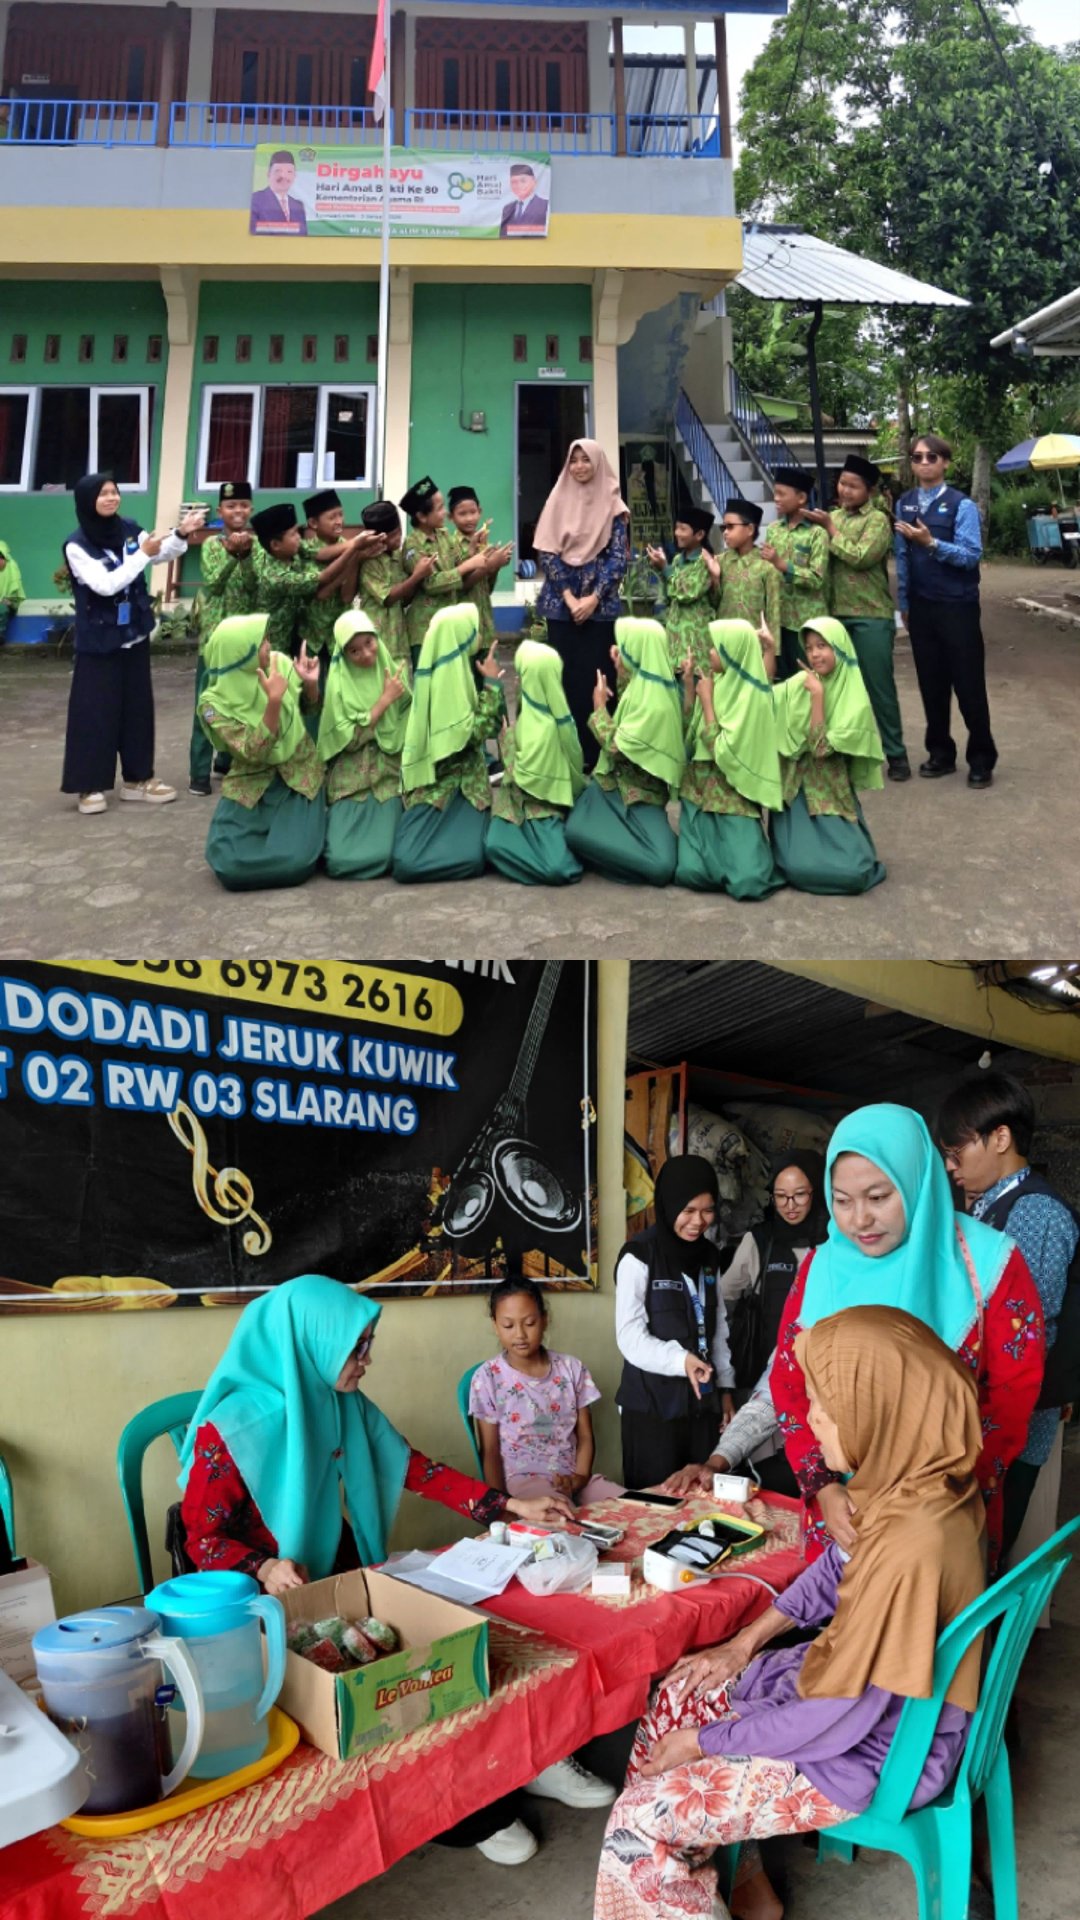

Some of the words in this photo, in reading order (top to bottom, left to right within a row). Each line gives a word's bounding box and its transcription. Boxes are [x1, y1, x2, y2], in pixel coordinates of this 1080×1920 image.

[317, 163, 423, 181] Dirgahayu
[316, 183, 339, 191] Hari
[342, 184, 373, 193] Amal
[375, 185, 404, 194] Bkti
[408, 186, 422, 194] Ke
[425, 186, 438, 194] 80
[316, 194, 378, 202] Kementerian
[220, 960, 328, 1001] 6973
[342, 974, 433, 1021] 2616
[221, 1019, 341, 1071] JERUK
[352, 1039, 456, 1087] KUWIK
[27, 1055, 90, 1101] 02
[107, 1064, 179, 1108] RW
[193, 1074, 242, 1115] 03
[256, 1081, 417, 1132] SLARANG
[375, 1687, 398, 1710] Le
